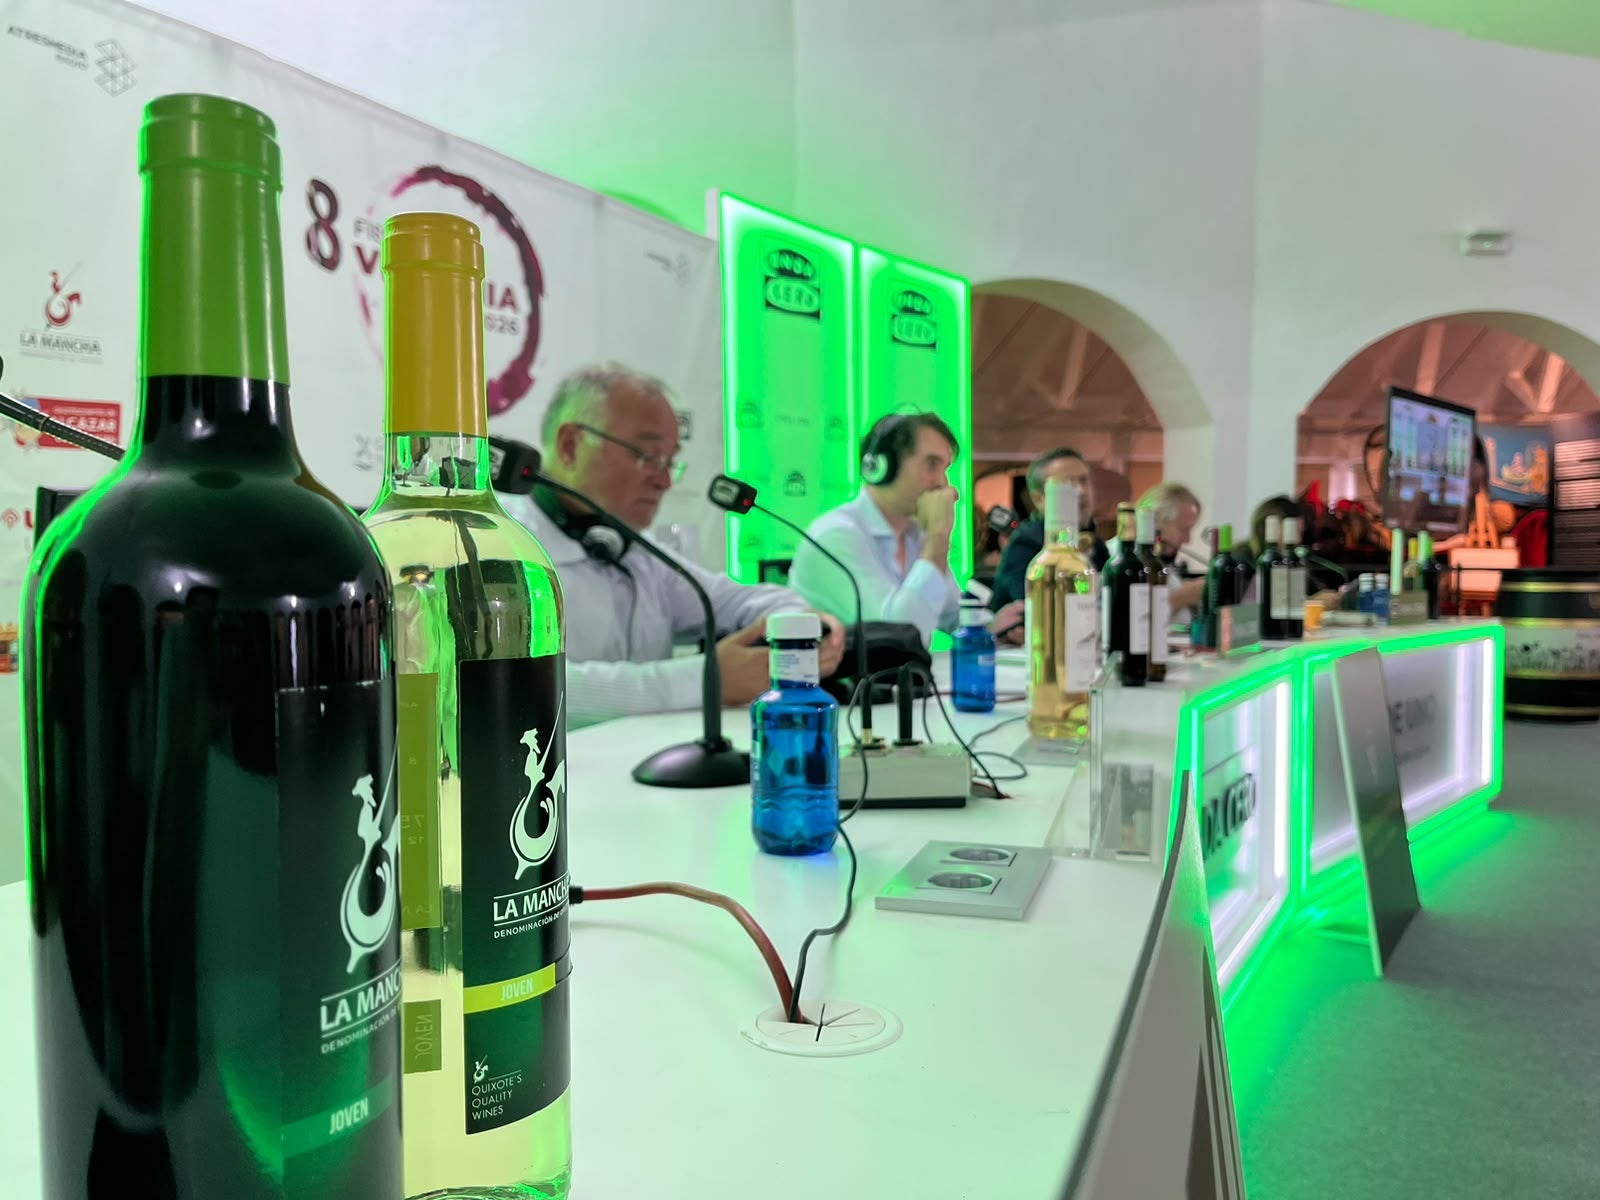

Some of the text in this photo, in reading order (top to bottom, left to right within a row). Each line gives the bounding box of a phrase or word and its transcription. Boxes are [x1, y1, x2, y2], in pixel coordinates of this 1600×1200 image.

[305, 178, 340, 272] 8
[494, 898, 518, 921] LA
[501, 978, 534, 1001] JOVEN
[321, 998, 352, 1031] LA
[471, 1074, 523, 1096] QUIXOTE'S
[471, 1089, 514, 1108] QUALITY
[329, 1096, 369, 1135] JOVEN
[471, 1105, 504, 1121] WINES
